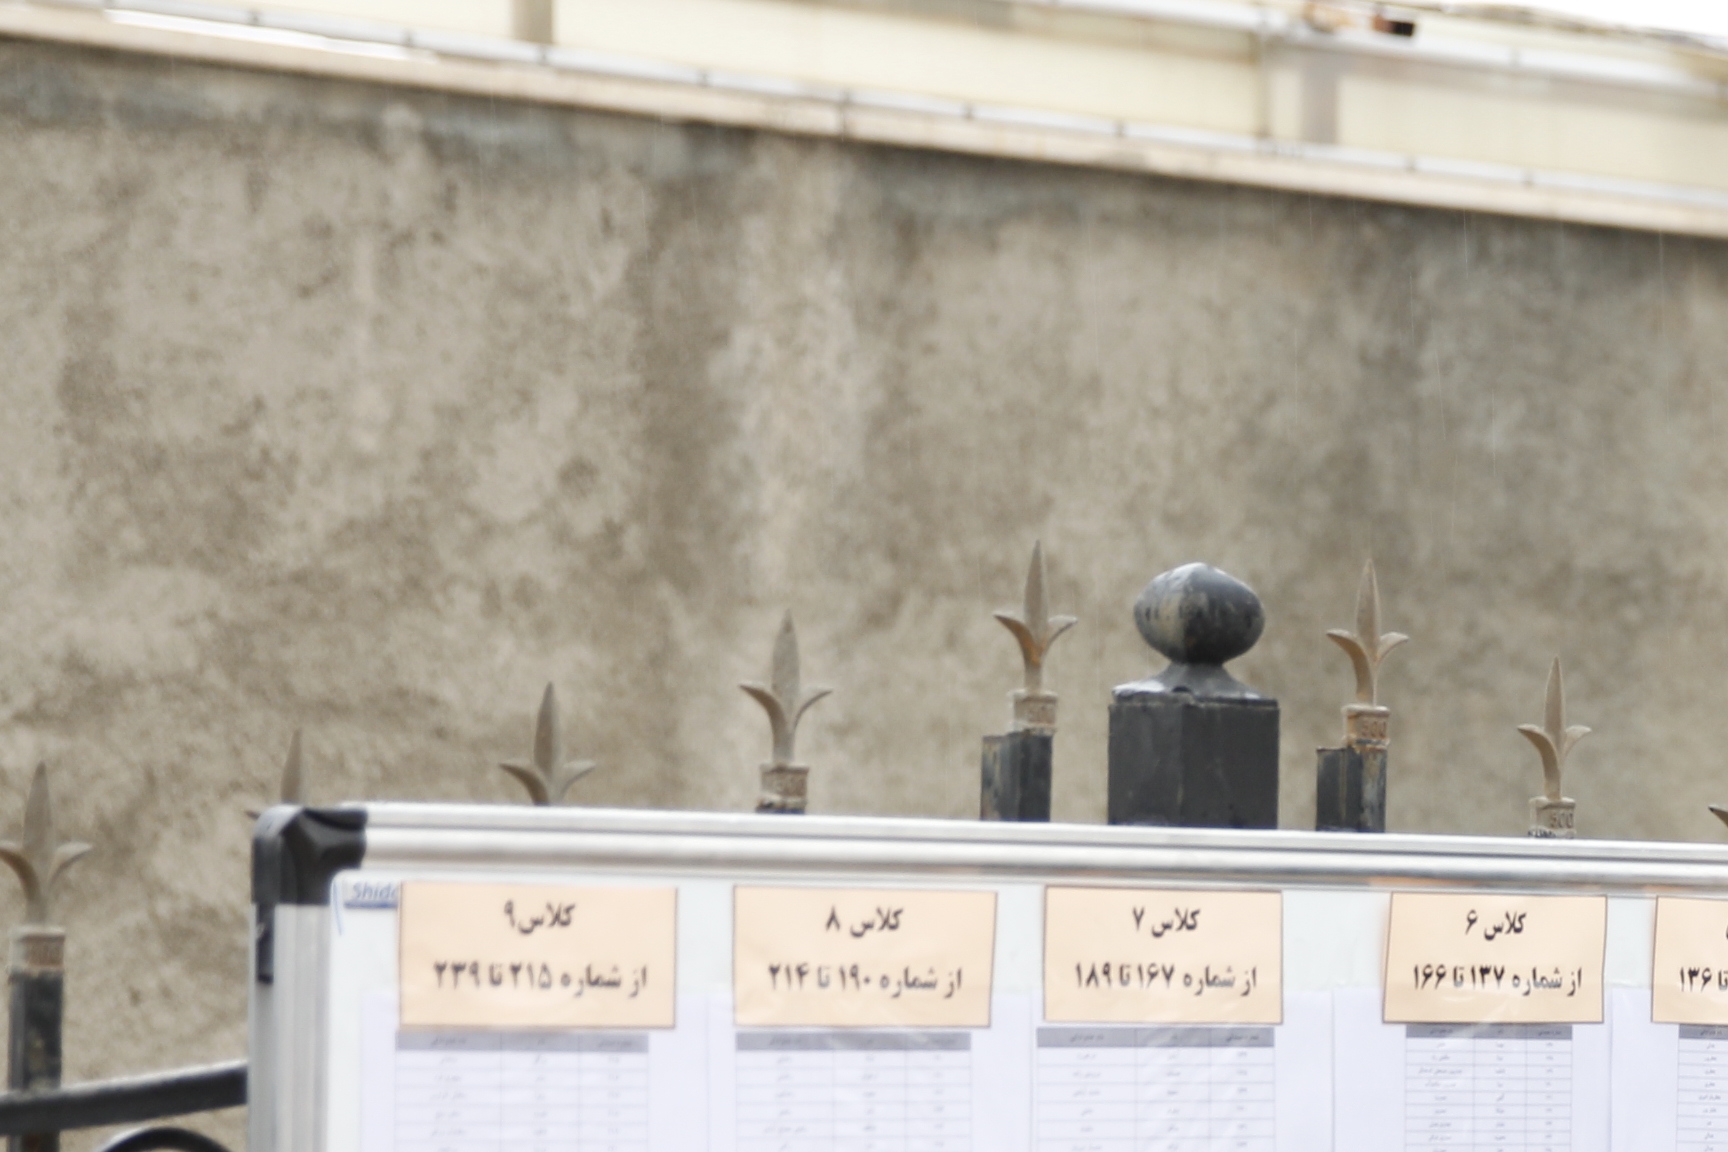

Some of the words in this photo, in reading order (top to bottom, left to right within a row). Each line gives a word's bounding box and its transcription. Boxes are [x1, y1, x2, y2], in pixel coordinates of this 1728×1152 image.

[825, 906, 841, 931] ۸
[849, 906, 904, 939] کلاس
[1131, 906, 1145, 931] ۷
[1150, 907, 1201, 939] کلاس
[1465, 909, 1479, 935] ۶
[1483, 911, 1527, 942] کلاس
[432, 960, 481, 988] ۲۳۹
[487, 963, 504, 988] تا
[508, 962, 553, 990] ۲۱۵
[560, 963, 623, 998] شماره
[628, 964, 648, 999] از
[767, 962, 810, 987] ۲۱۴
[816, 965, 831, 990] تا
[838, 963, 872, 990] ۱۹۰
[879, 966, 939, 1000] شماره
[943, 967, 963, 1000] از
[1075, 961, 1112, 988] ۱۸۹
[1118, 963, 1131, 987] تا
[1136, 962, 1176, 987] ۱۶۷
[1182, 965, 1236, 997] شماره
[1239, 966, 1257, 998] از
[1413, 963, 1447, 989] ۱۶۶
[1452, 965, 1465, 988] تا
[1470, 964, 1506, 986] ۱۳۷
[1512, 966, 1563, 997] شماره
[1566, 967, 1583, 998] از
[1679, 966, 1713, 991] ۱۳۶
